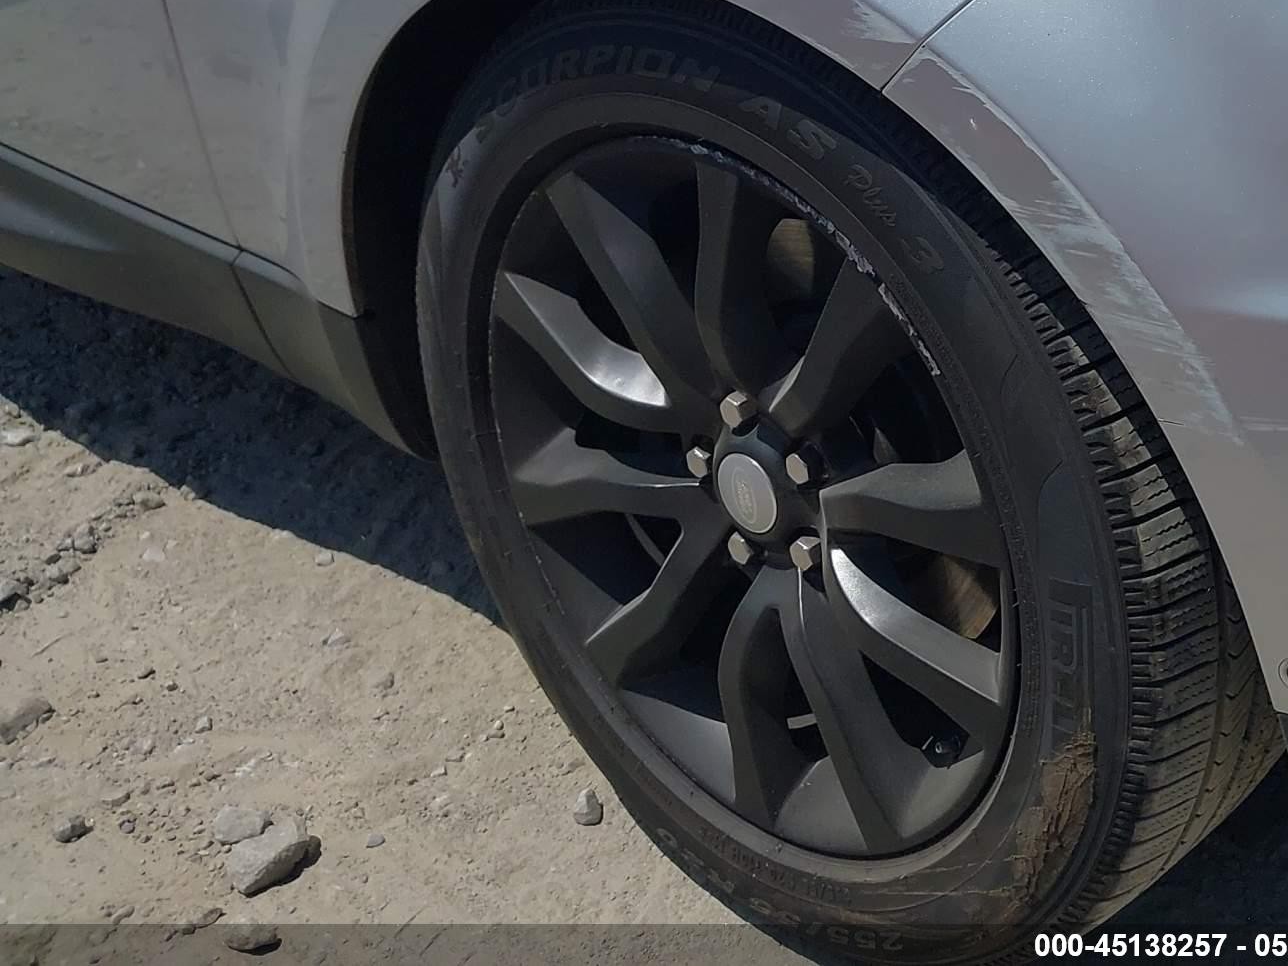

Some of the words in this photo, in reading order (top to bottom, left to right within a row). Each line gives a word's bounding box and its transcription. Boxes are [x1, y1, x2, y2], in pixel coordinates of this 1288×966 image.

[737, 95, 838, 161] AS
[844, 163, 897, 227] Plus
[901, 235, 945, 274] 3
